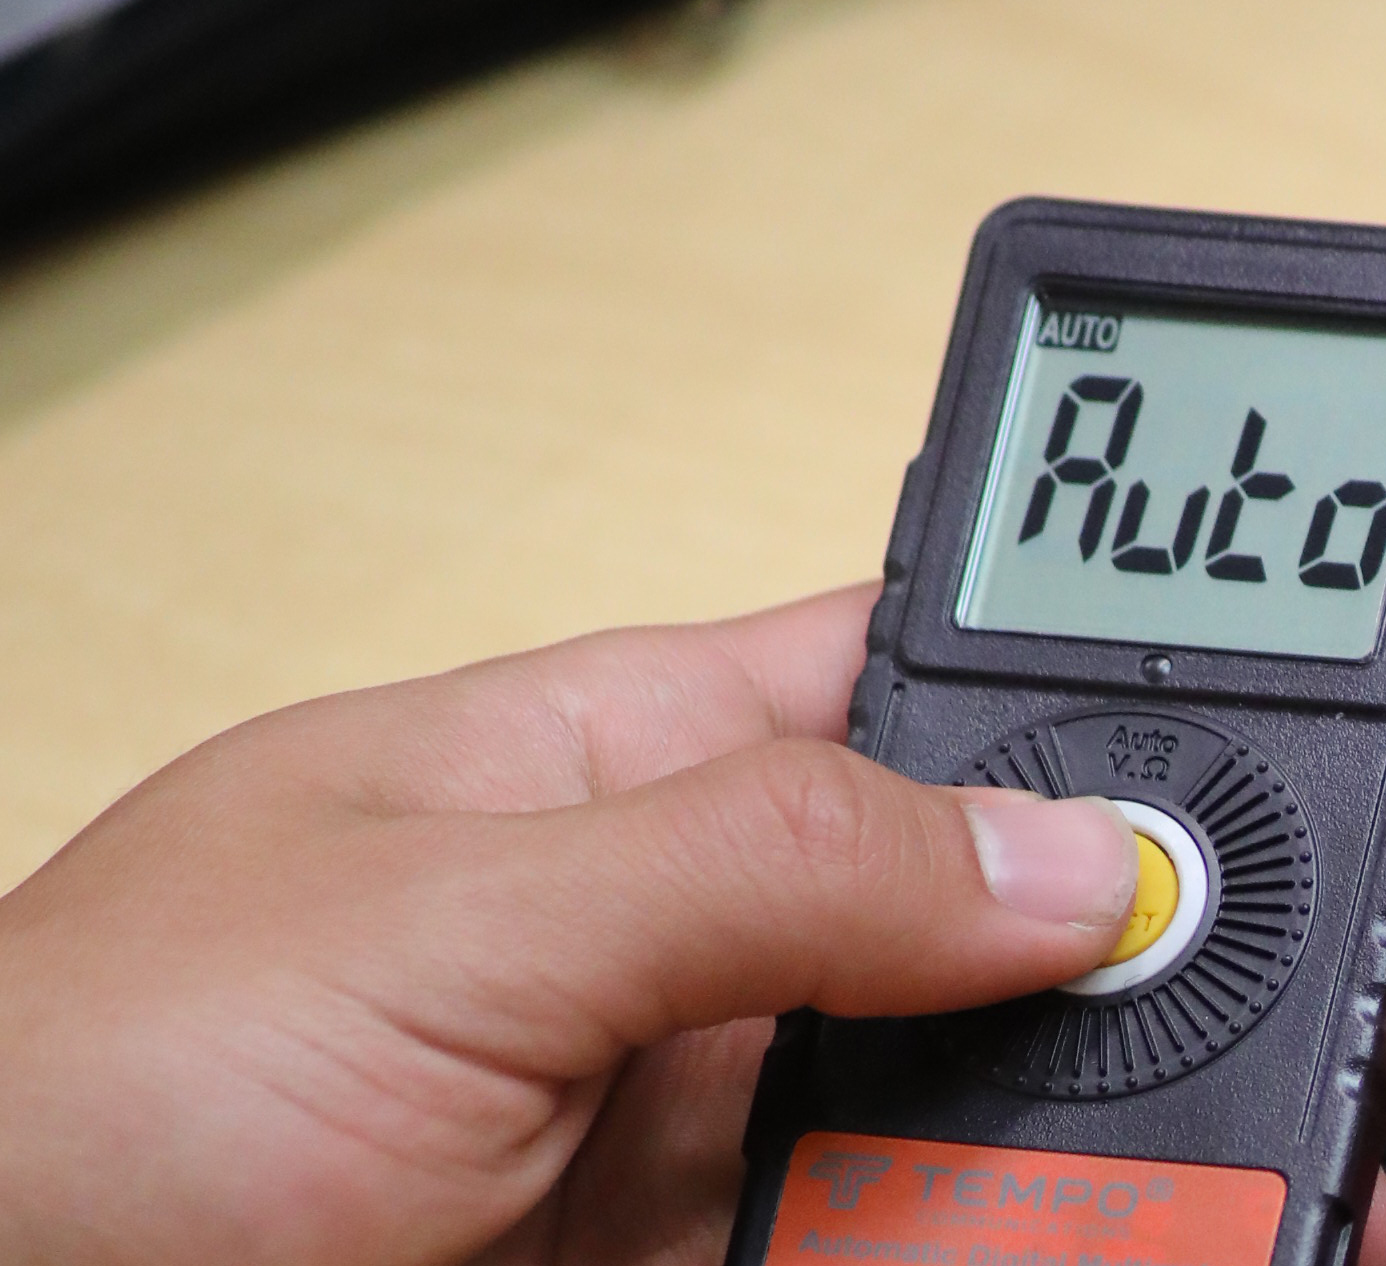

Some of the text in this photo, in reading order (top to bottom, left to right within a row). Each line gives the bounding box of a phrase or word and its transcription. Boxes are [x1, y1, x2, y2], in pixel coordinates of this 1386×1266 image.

[1038, 313, 1120, 349] AUTO
[1106, 724, 1179, 753] Auto
[916, 1209, 1131, 1241] COMMUNICATIONS
